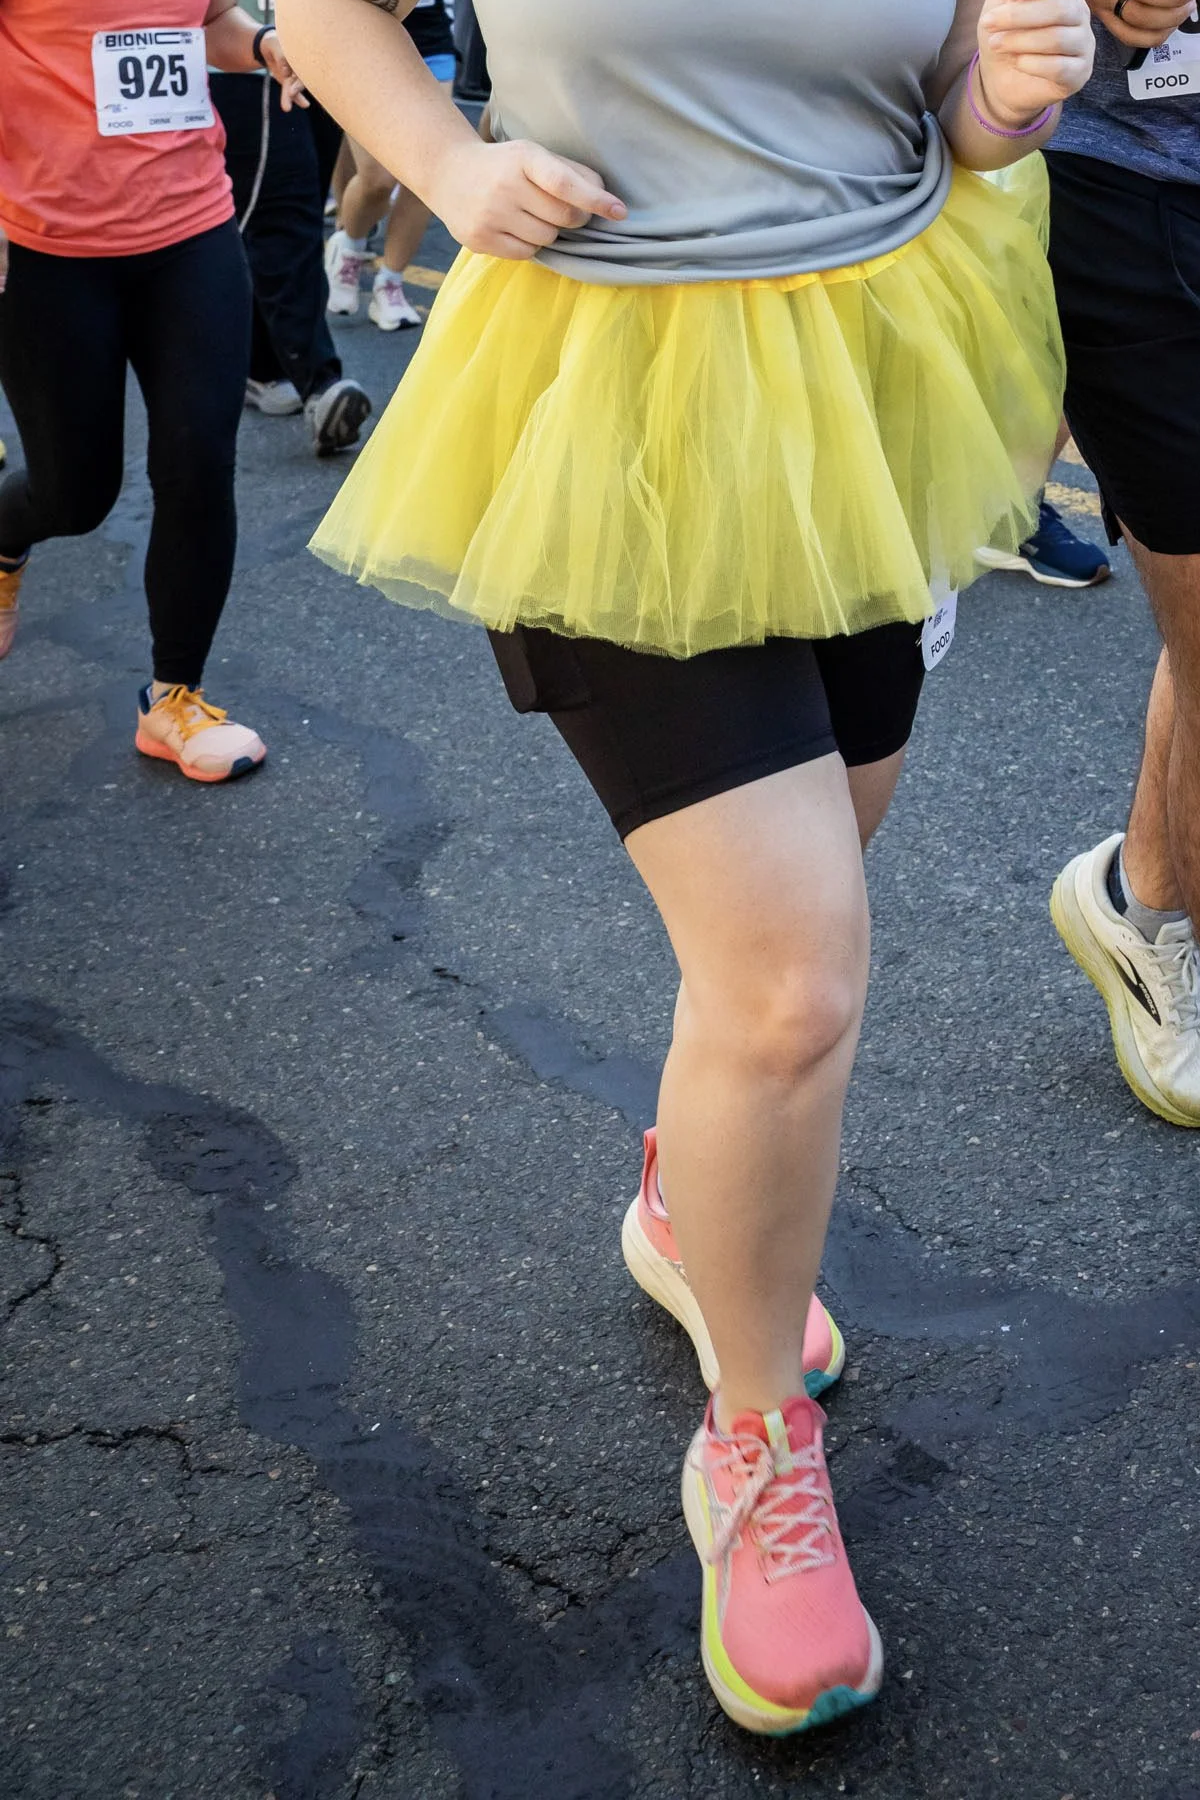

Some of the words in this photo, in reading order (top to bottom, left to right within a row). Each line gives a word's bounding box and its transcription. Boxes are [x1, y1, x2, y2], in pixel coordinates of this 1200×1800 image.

[105, 32, 180, 48] BIONIC
[118, 55, 188, 99] 925
[1145, 74, 1190, 90] FOOD
[930, 631, 950, 657] FOOD
